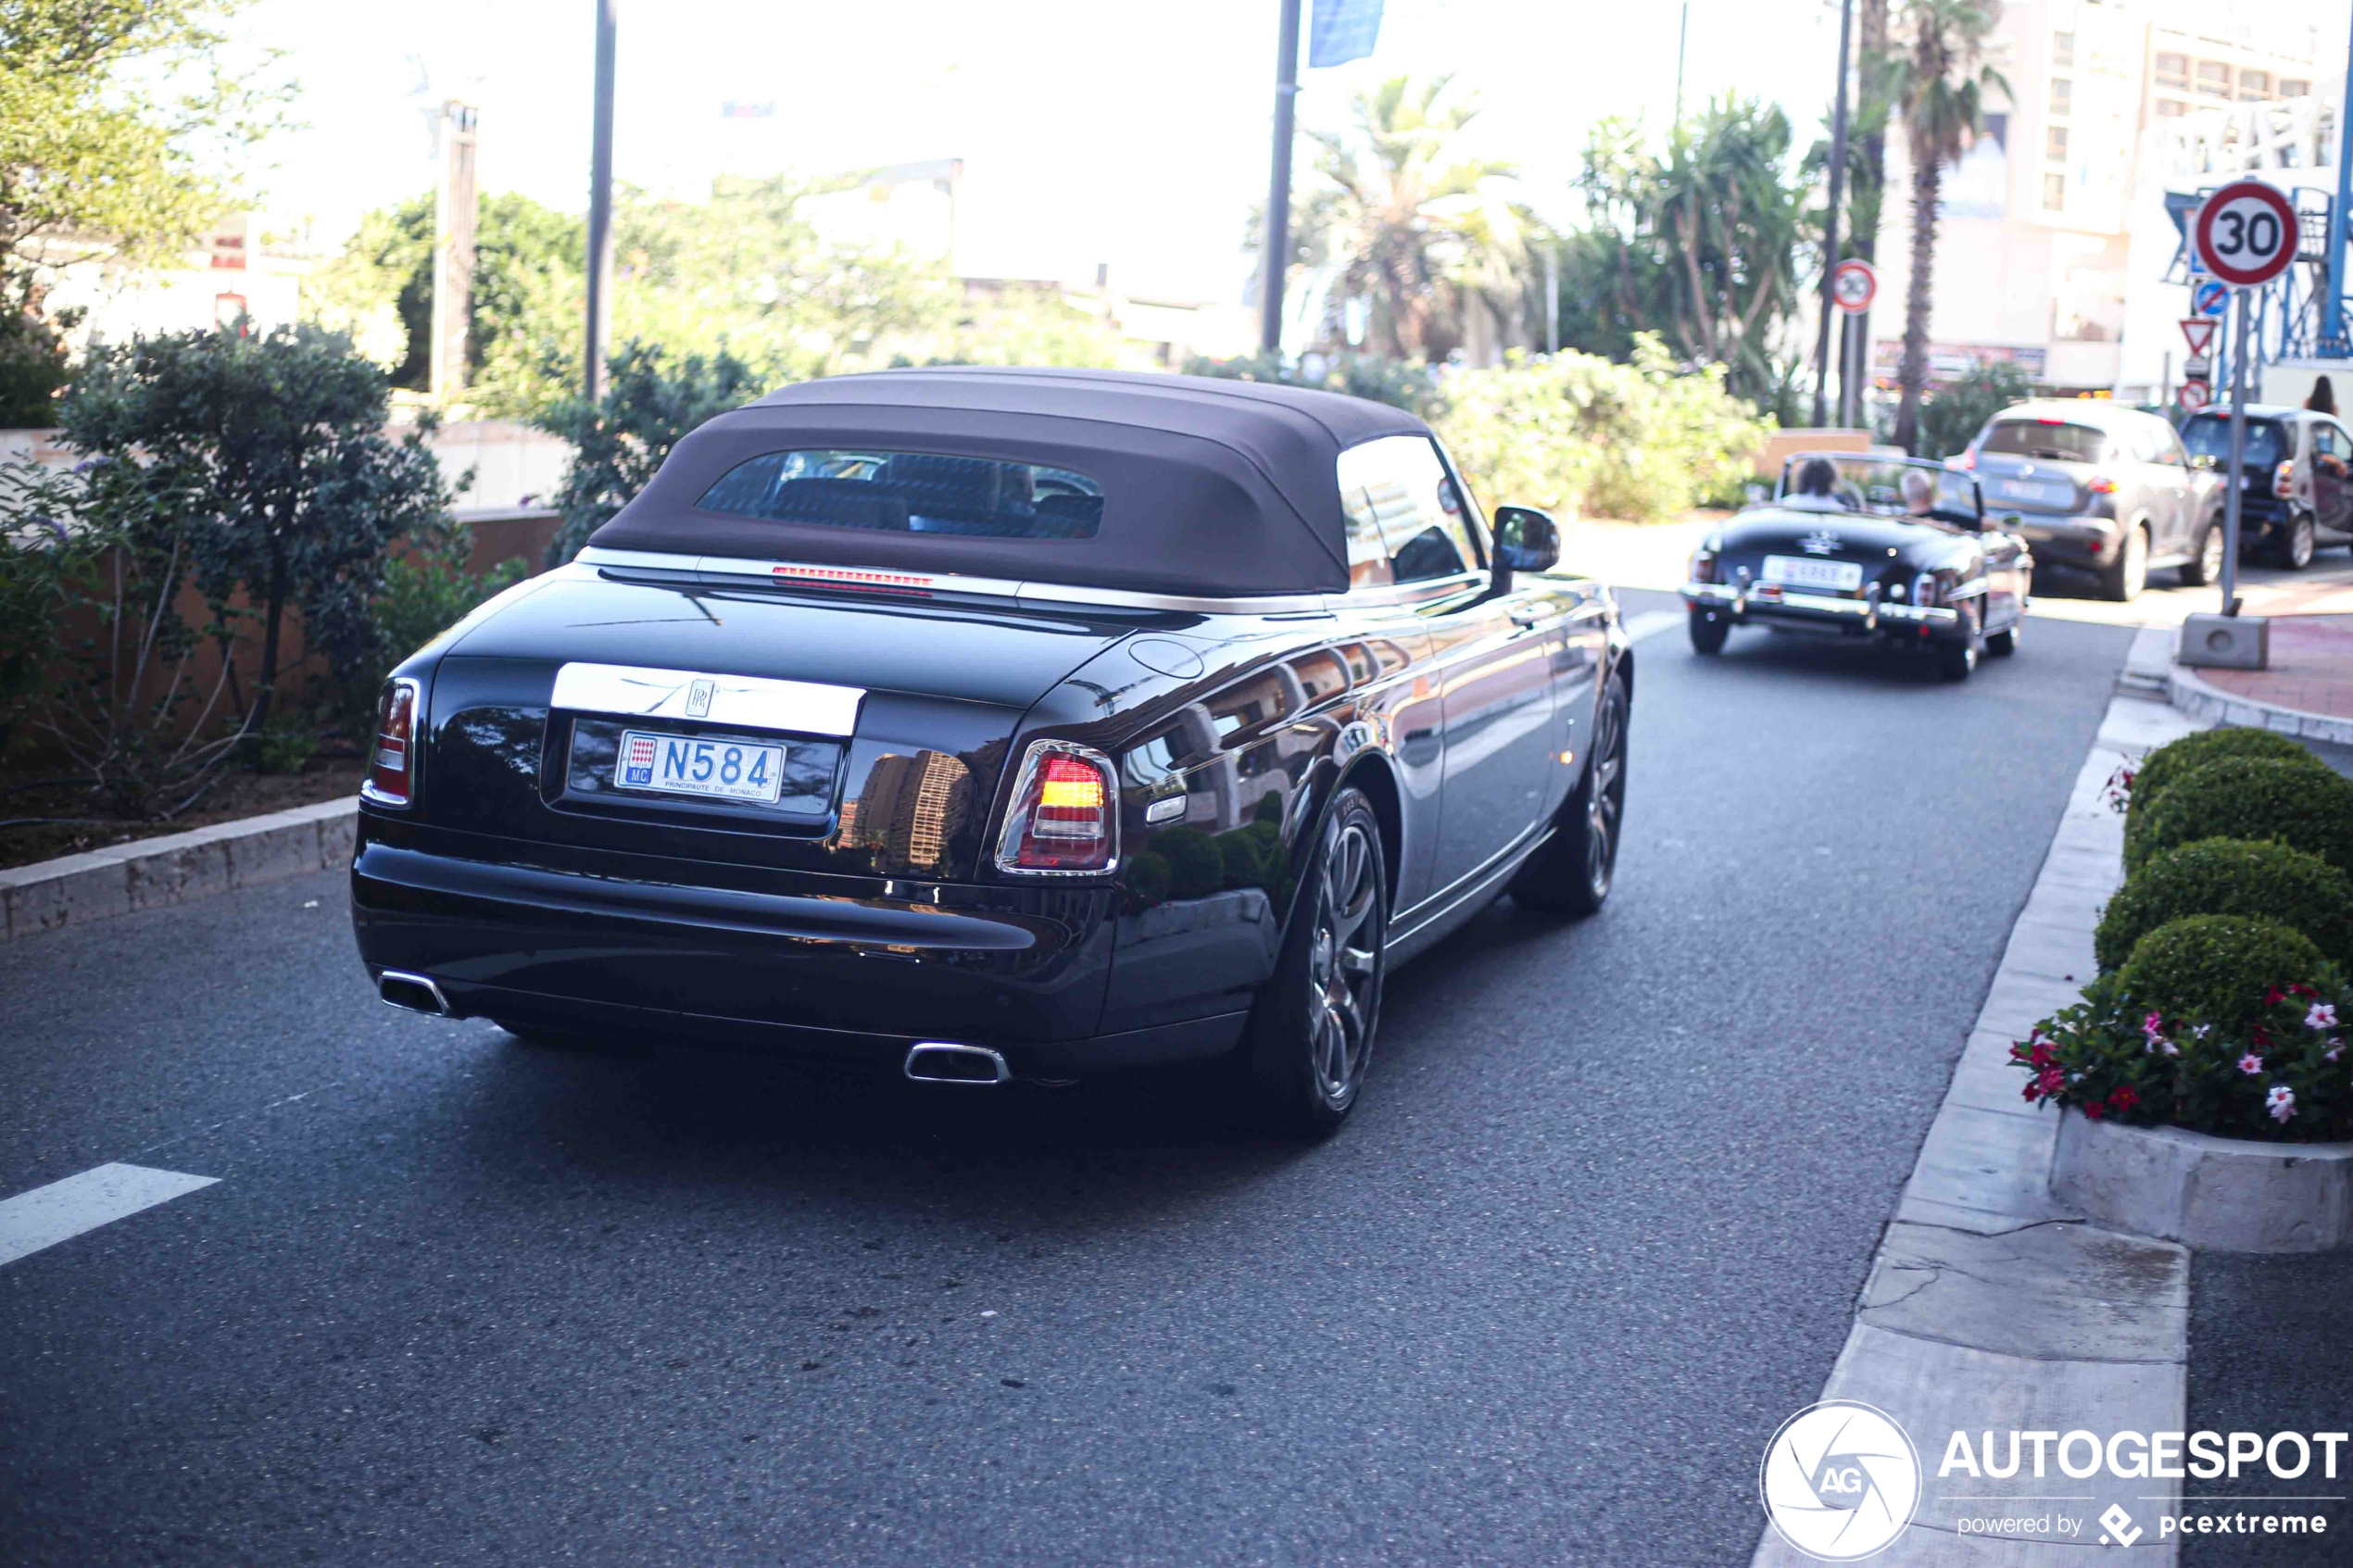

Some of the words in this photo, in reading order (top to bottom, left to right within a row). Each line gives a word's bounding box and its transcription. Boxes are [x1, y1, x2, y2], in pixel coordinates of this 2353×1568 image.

[2217, 210, 2279, 257] 30
[632, 770, 648, 782] MC
[663, 742, 768, 786] N584
[665, 781, 710, 792] PRINCIPAUTE
[729, 787, 761, 797] MONACO
